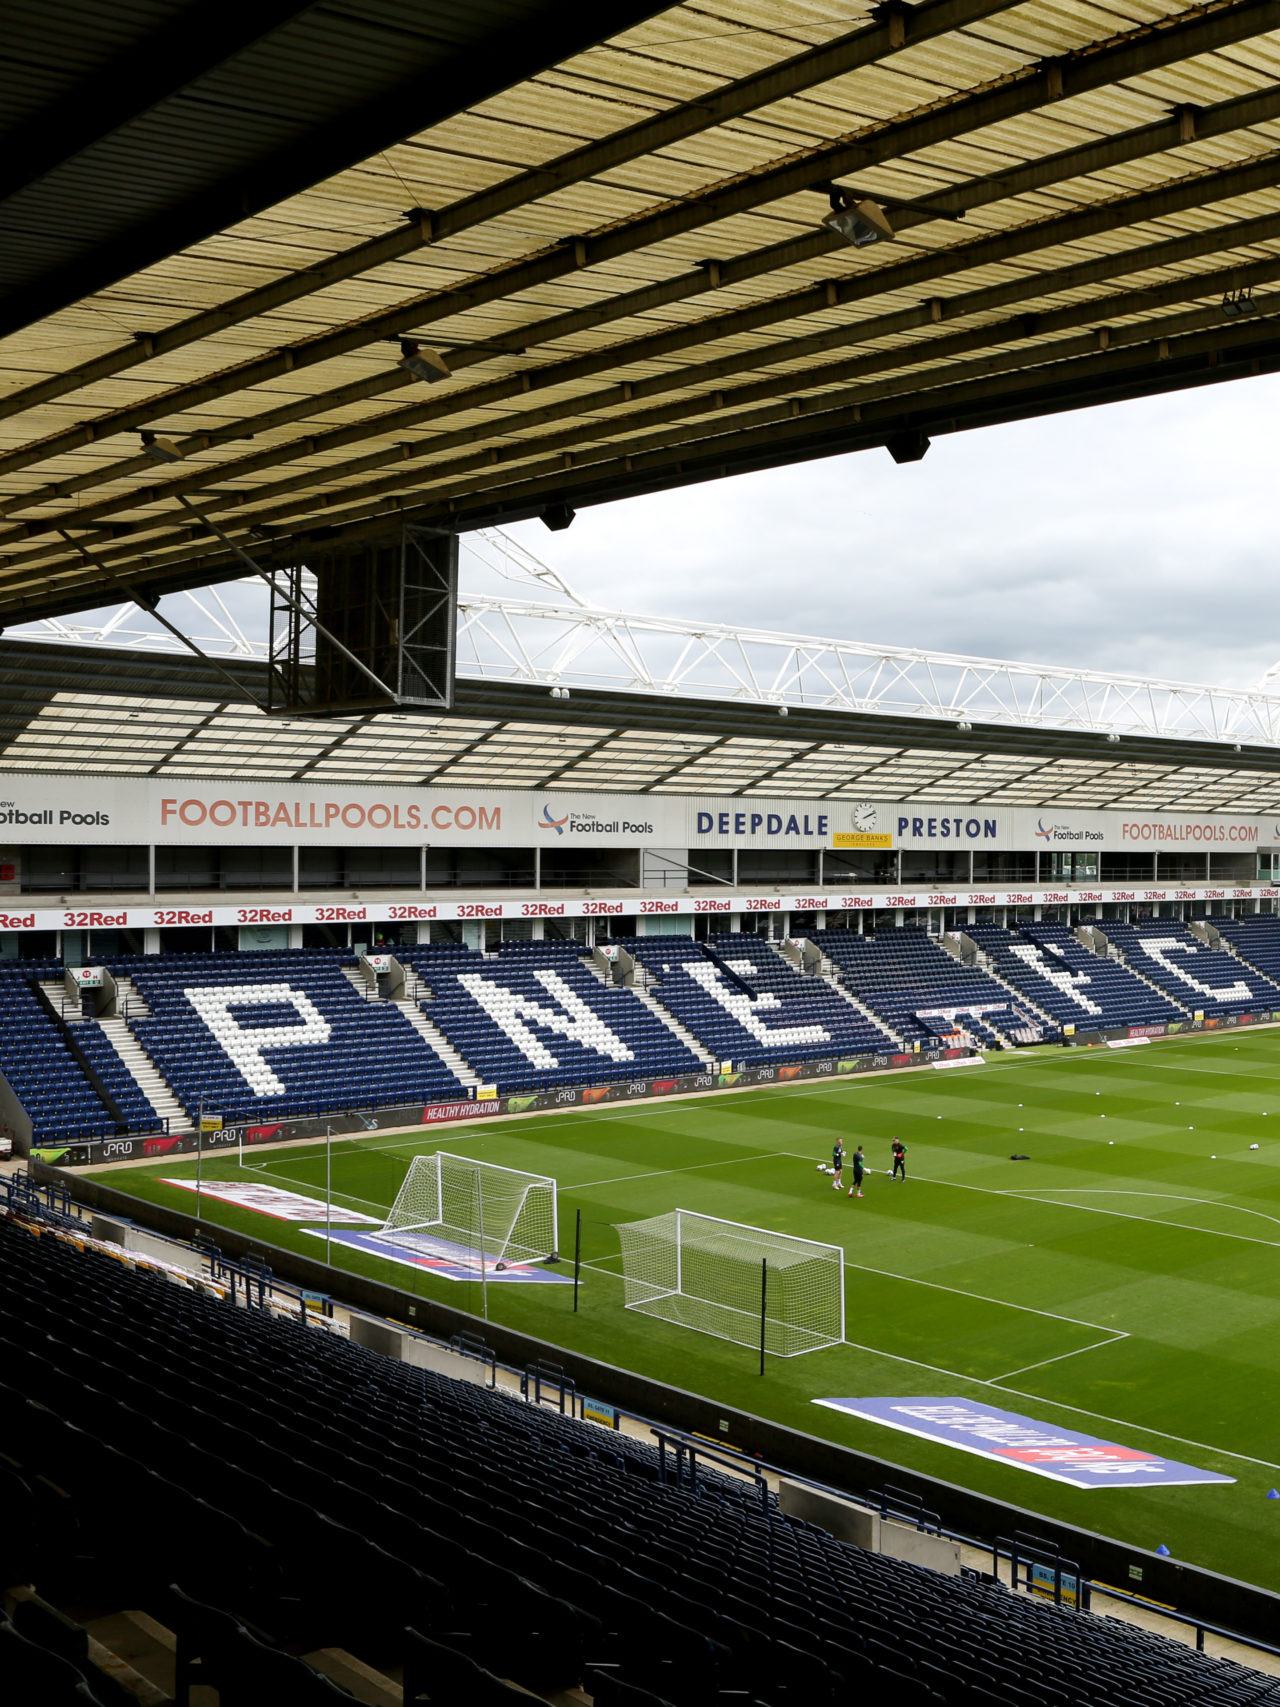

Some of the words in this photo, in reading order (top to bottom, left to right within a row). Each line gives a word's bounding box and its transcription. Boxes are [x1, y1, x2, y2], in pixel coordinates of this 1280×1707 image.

[60, 810, 110, 825] Pools
[161, 799, 501, 830] FOOTBALLPOOLS.COM
[570, 812, 581, 820] The
[570, 821, 619, 833] Football
[622, 821, 654, 834] Pools
[697, 812, 828, 836] DEEPDALE
[898, 817, 997, 838] PRESTON
[1122, 823, 1259, 842] FOOTBALLPOOLS.COM
[1053, 831, 1084, 840] Football
[1085, 831, 1104, 841] Pools
[64, 912, 127, 927] 32Red
[154, 911, 213, 925] 32Red
[237, 909, 292, 922] 32Red
[315, 908, 366, 921] 32Red
[388, 906, 437, 919] 32Red
[457, 905, 502, 917] 32Red
[521, 904, 565, 916] 32Red
[582, 902, 623, 914] 32Red
[640, 901, 679, 913] 32Red
[694, 900, 731, 911] 32Red
[746, 899, 781, 910] 32Red
[795, 898, 828, 909] 32Red
[841, 897, 873, 908] 32Red
[886, 896, 916, 907] 32Red
[928, 895, 957, 905] 32Red
[968, 895, 996, 905] 32Red
[1006, 894, 1033, 904] 32Red
[1043, 893, 1069, 903] 32Red
[1078, 892, 1102, 902] 32Red
[1111, 892, 1135, 901] 32Red
[1144, 891, 1166, 900] 32Red
[427, 1105, 460, 1120] HEALTHY
[460, 1101, 500, 1116] HYDRATION
